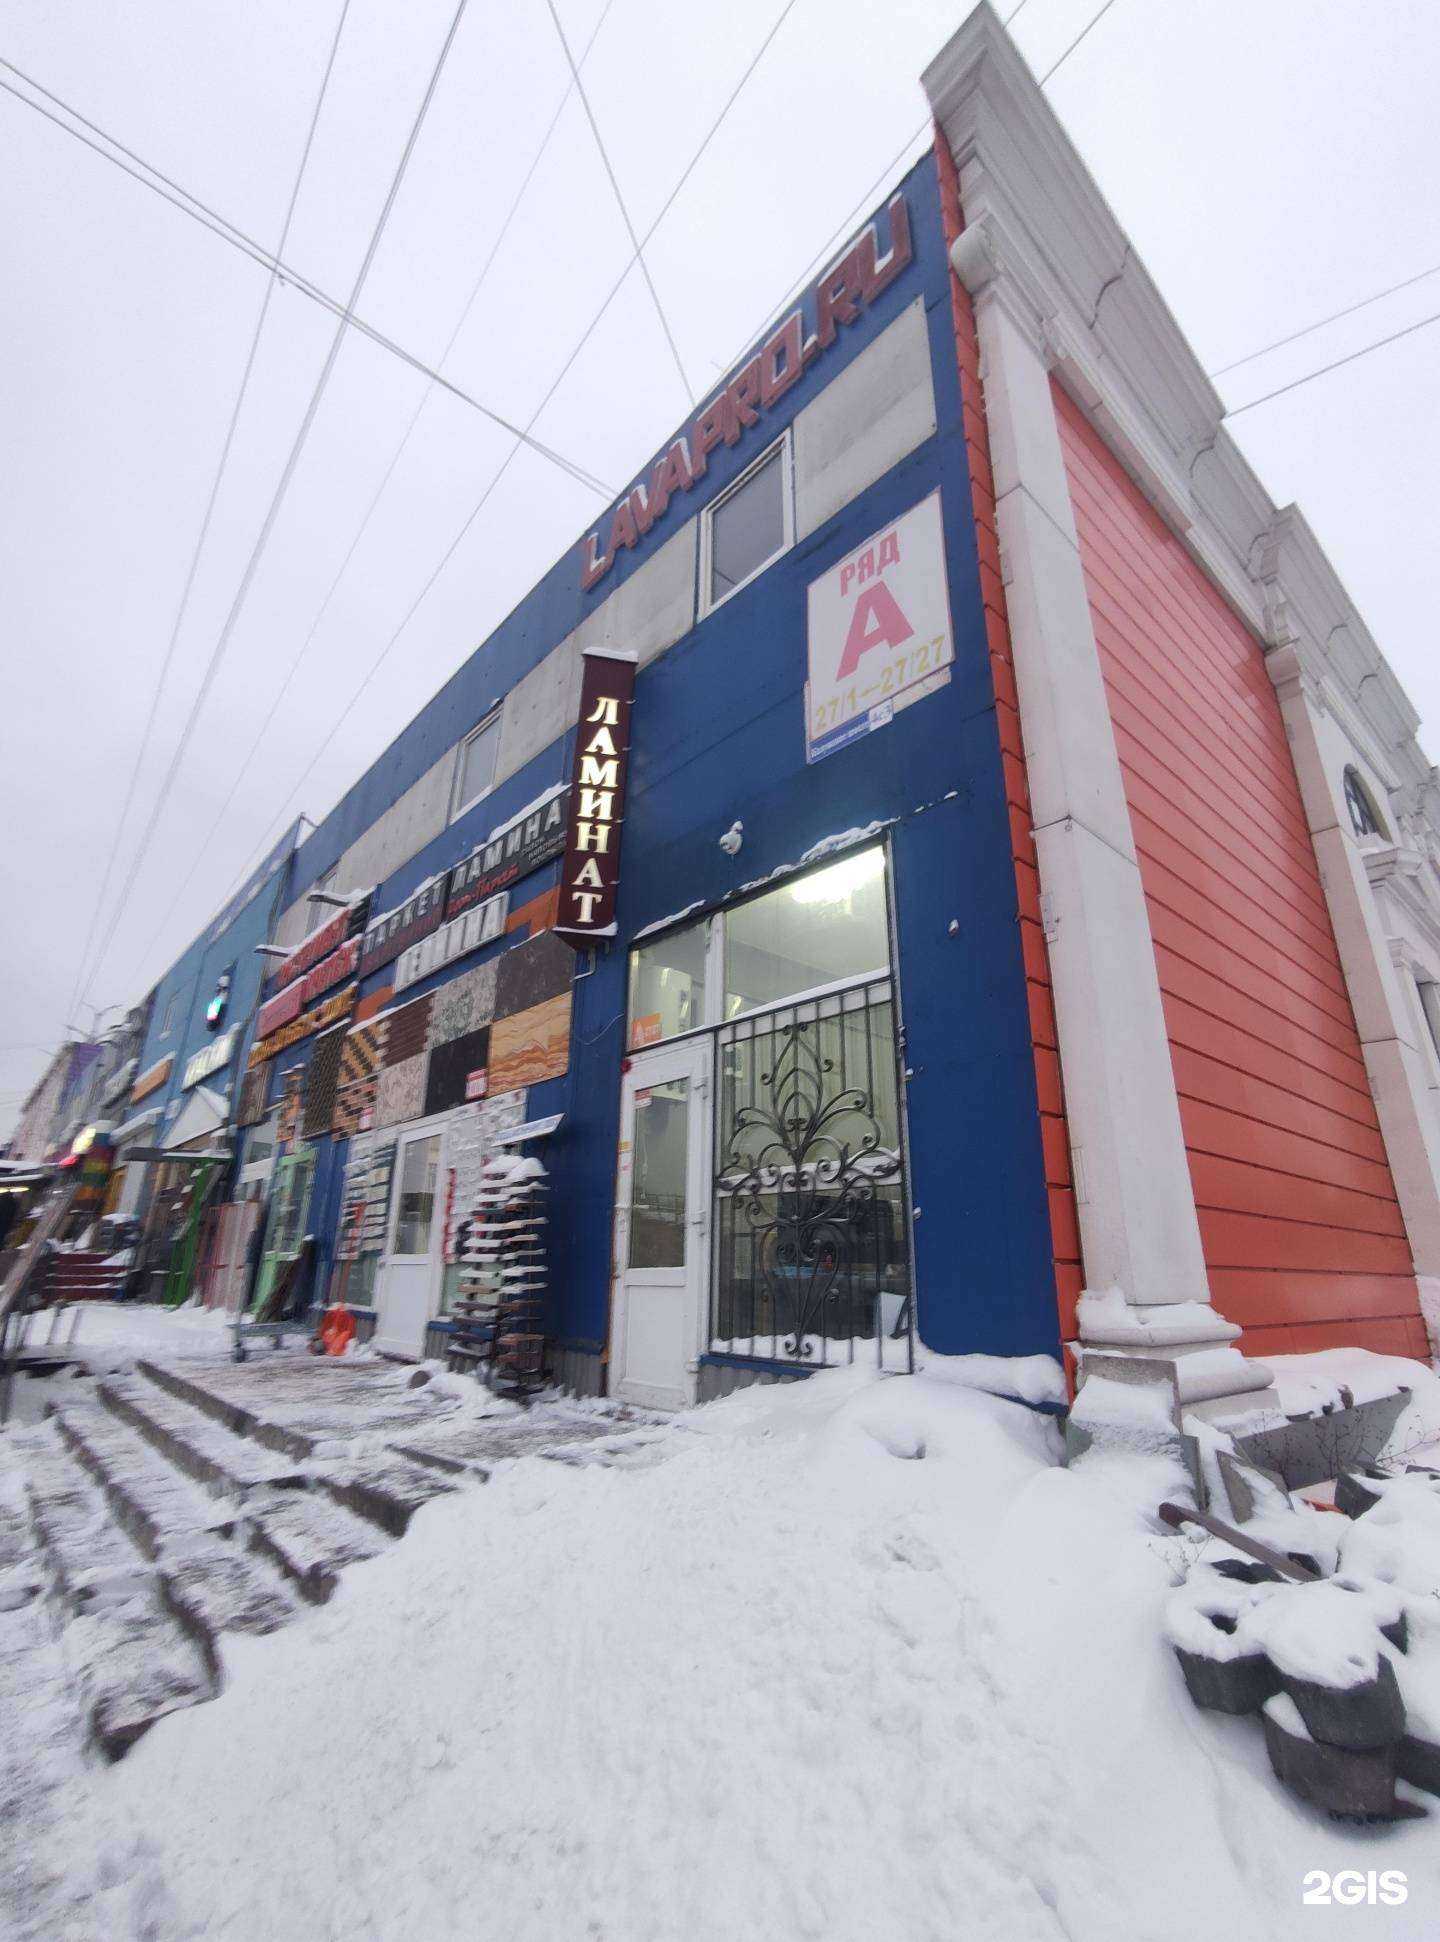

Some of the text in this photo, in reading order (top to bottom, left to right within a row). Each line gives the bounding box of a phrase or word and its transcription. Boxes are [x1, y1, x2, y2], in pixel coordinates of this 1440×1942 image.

[580, 191, 913, 592] LAVAPRO.RU
[840, 531, 901, 597] РЯД
[836, 580, 915, 682] А
[451, 793, 570, 894] ЛАМИНА
[571, 697, 620, 923] ЛАМИНАТ
